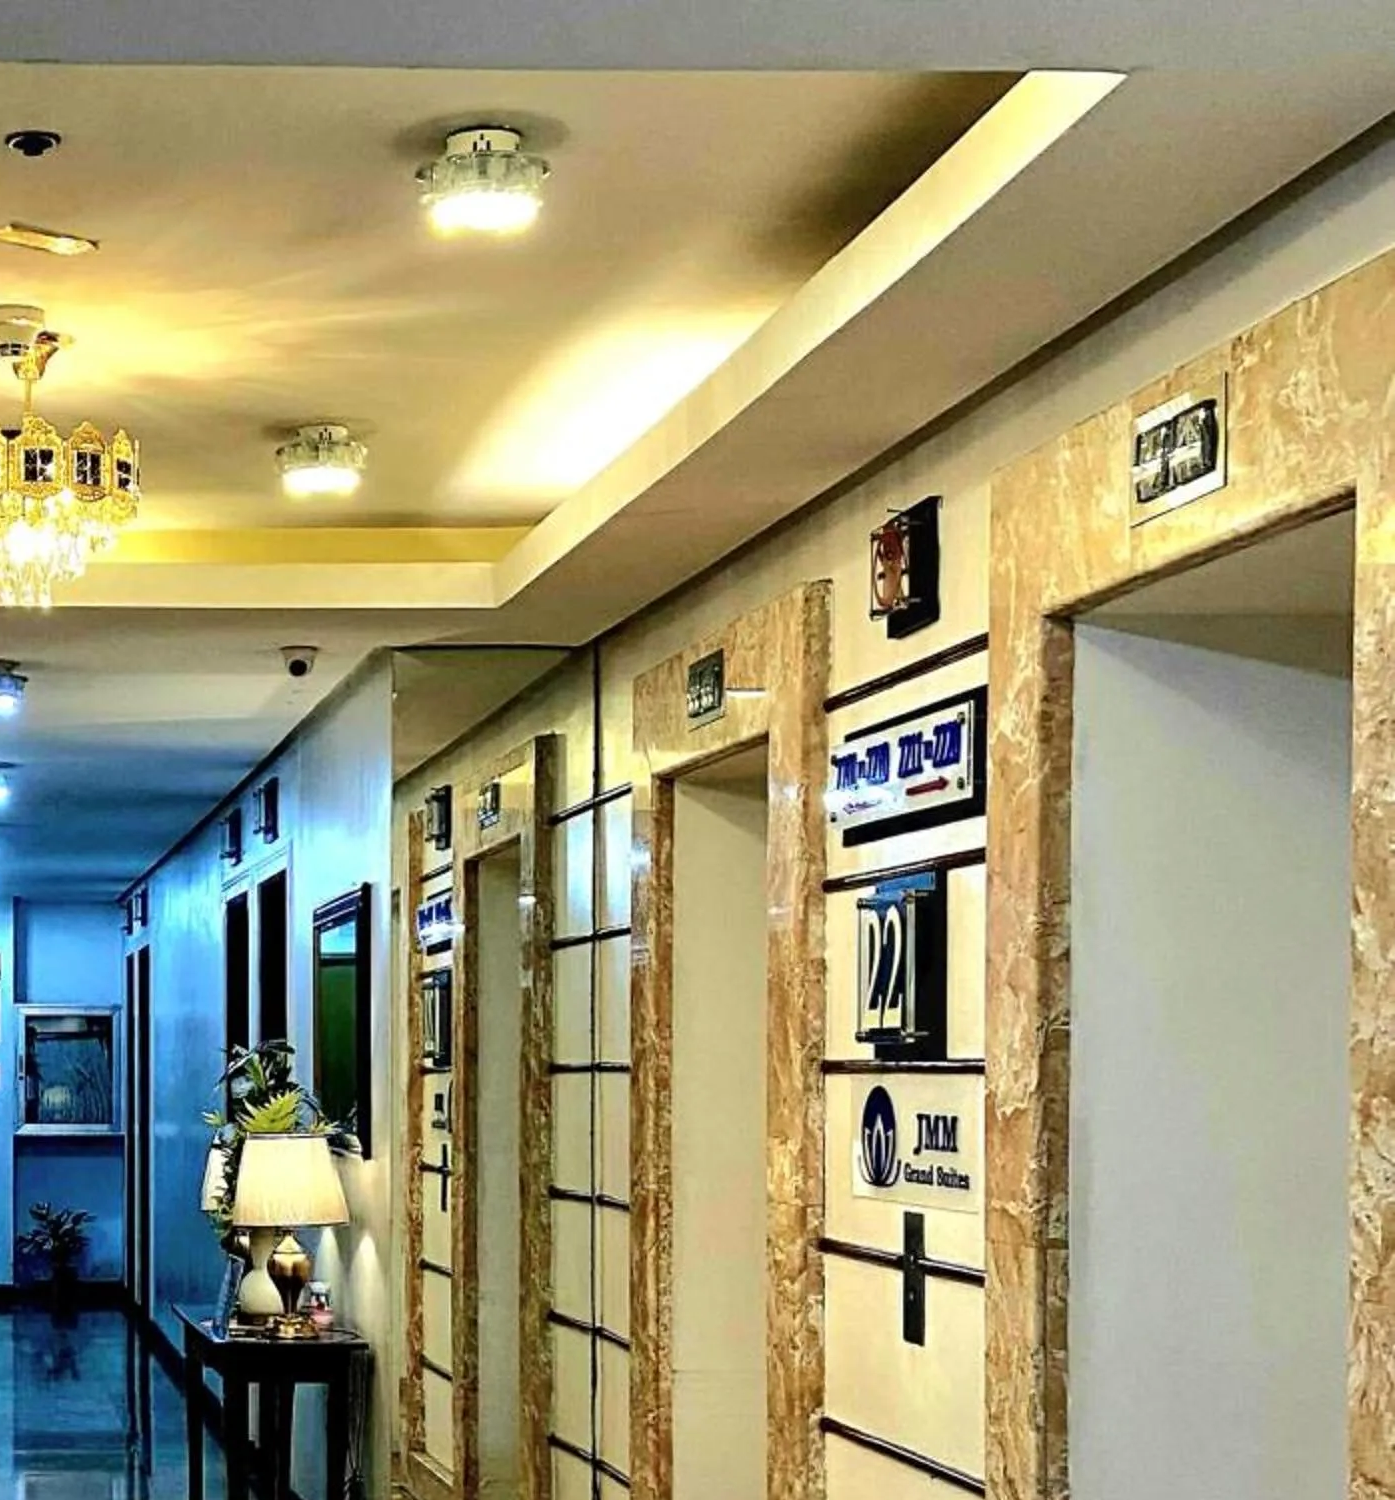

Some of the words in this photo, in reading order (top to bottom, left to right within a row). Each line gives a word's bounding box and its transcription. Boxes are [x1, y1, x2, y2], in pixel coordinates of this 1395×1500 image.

[862, 905, 903, 1029] 22
[913, 1113, 958, 1155] JMM
[904, 1162, 933, 1186] Grand
[936, 1166, 970, 1190] Suites
